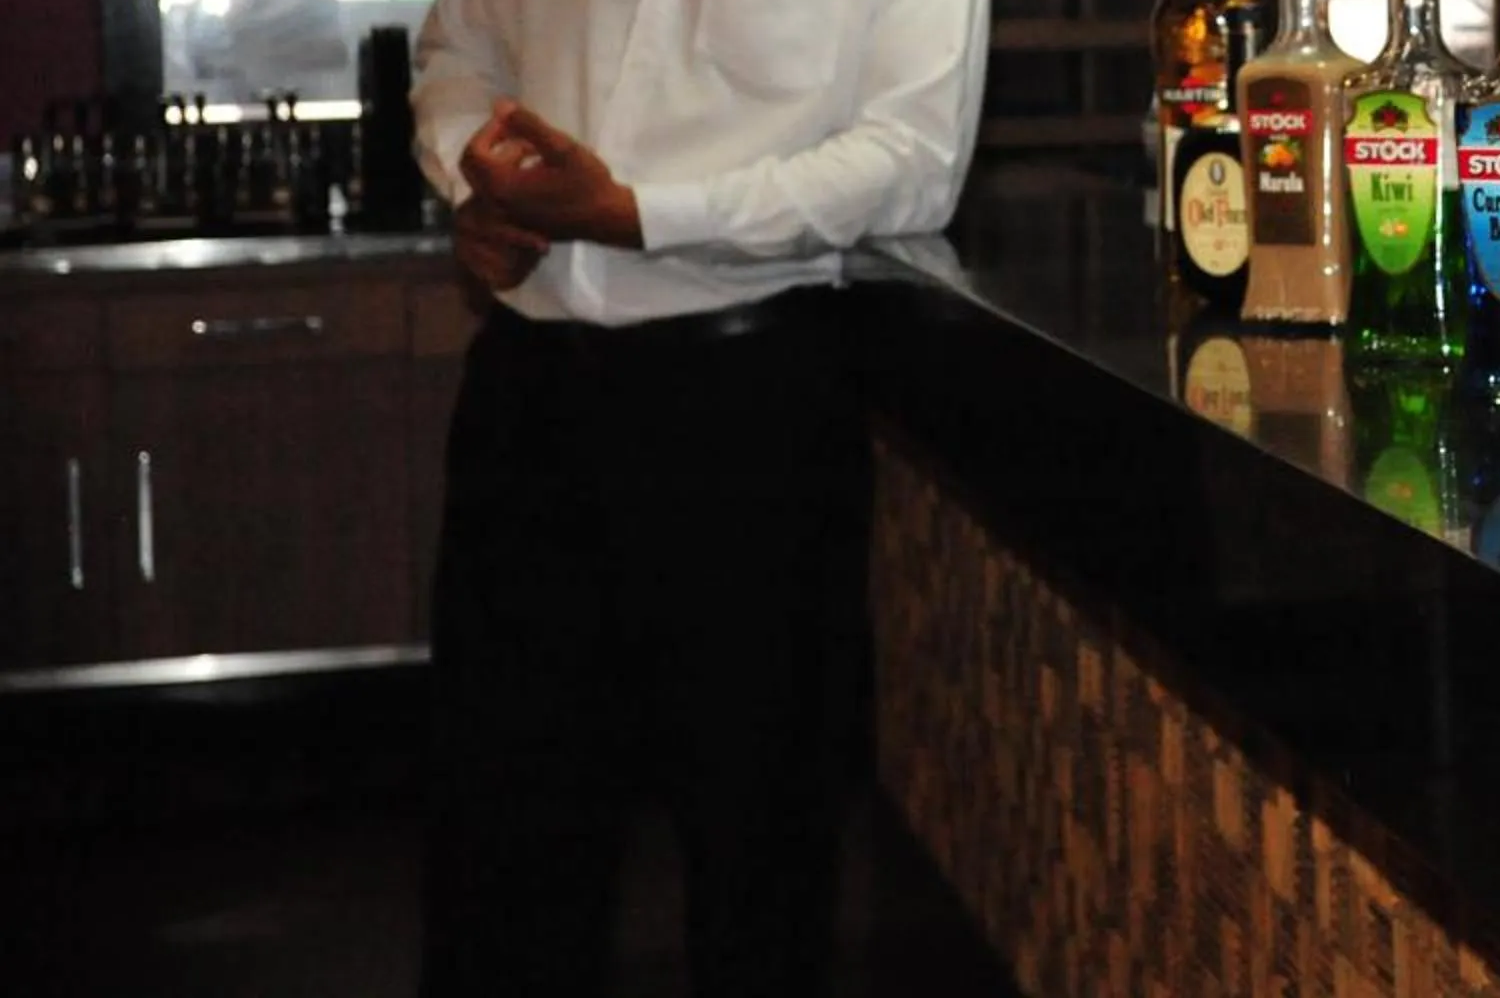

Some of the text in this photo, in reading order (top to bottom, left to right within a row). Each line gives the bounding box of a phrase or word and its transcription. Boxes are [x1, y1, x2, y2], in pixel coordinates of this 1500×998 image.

[1250, 113, 1306, 131] STOCK
[1354, 140, 1426, 162] STOCK
[1370, 173, 1413, 202] Kiwi
